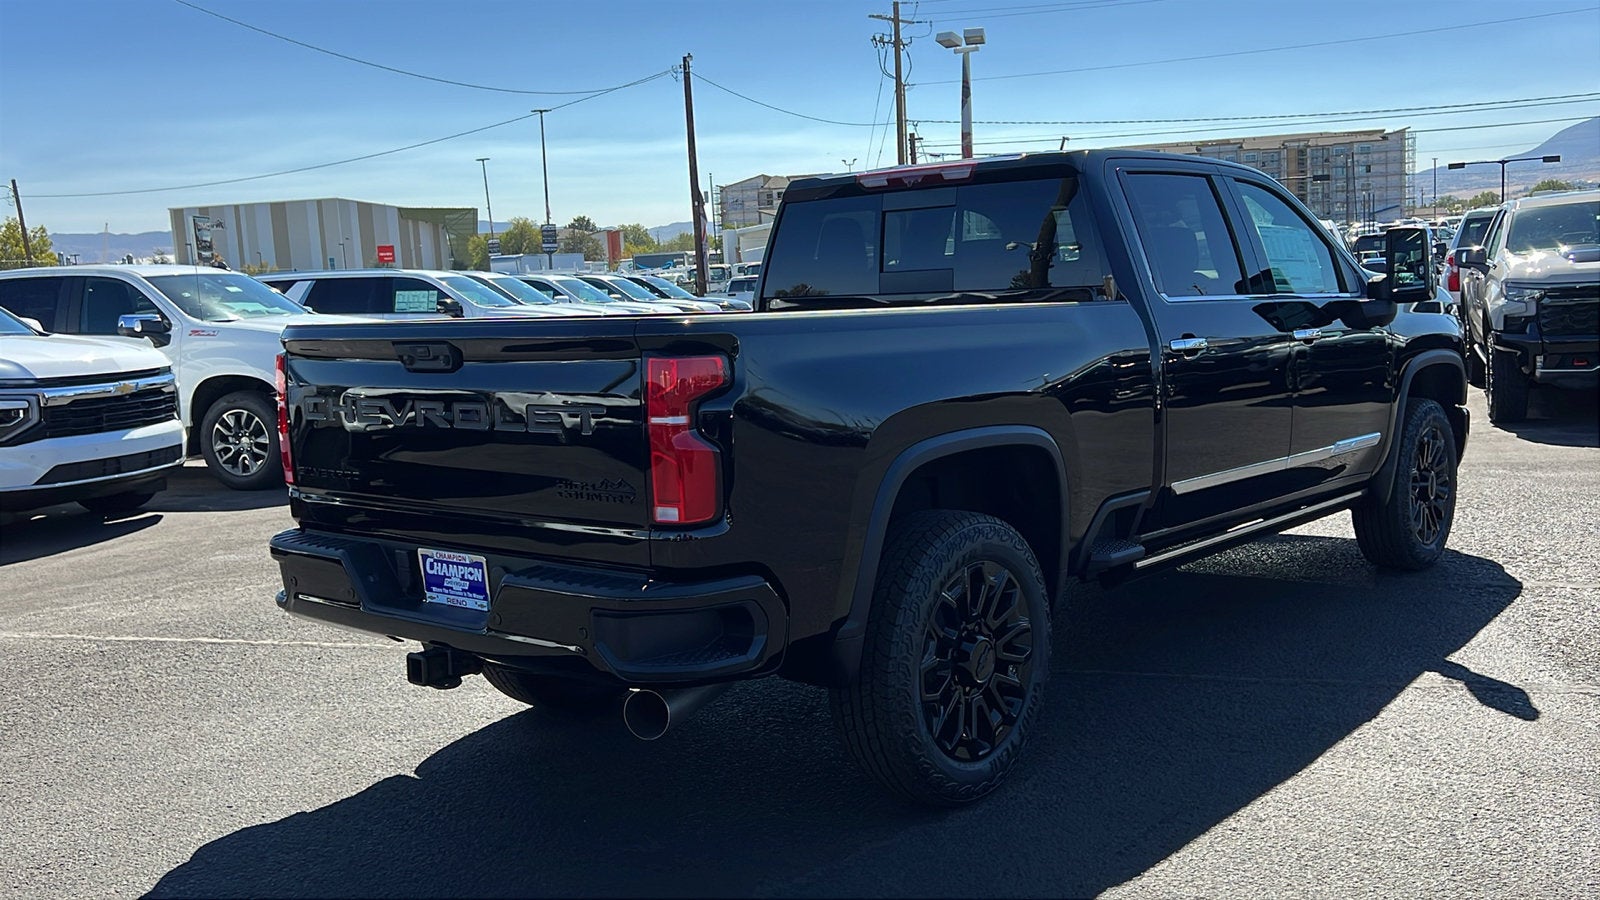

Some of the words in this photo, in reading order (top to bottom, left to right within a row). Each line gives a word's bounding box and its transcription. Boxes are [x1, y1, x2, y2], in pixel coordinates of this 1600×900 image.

[303, 394, 607, 436] CHEVROLET
[556, 489, 636, 504] COUNTRY
[435, 552, 467, 562] CHAMPION
[426, 557, 482, 582] CHAMPION
[447, 598, 468, 607] RENO
